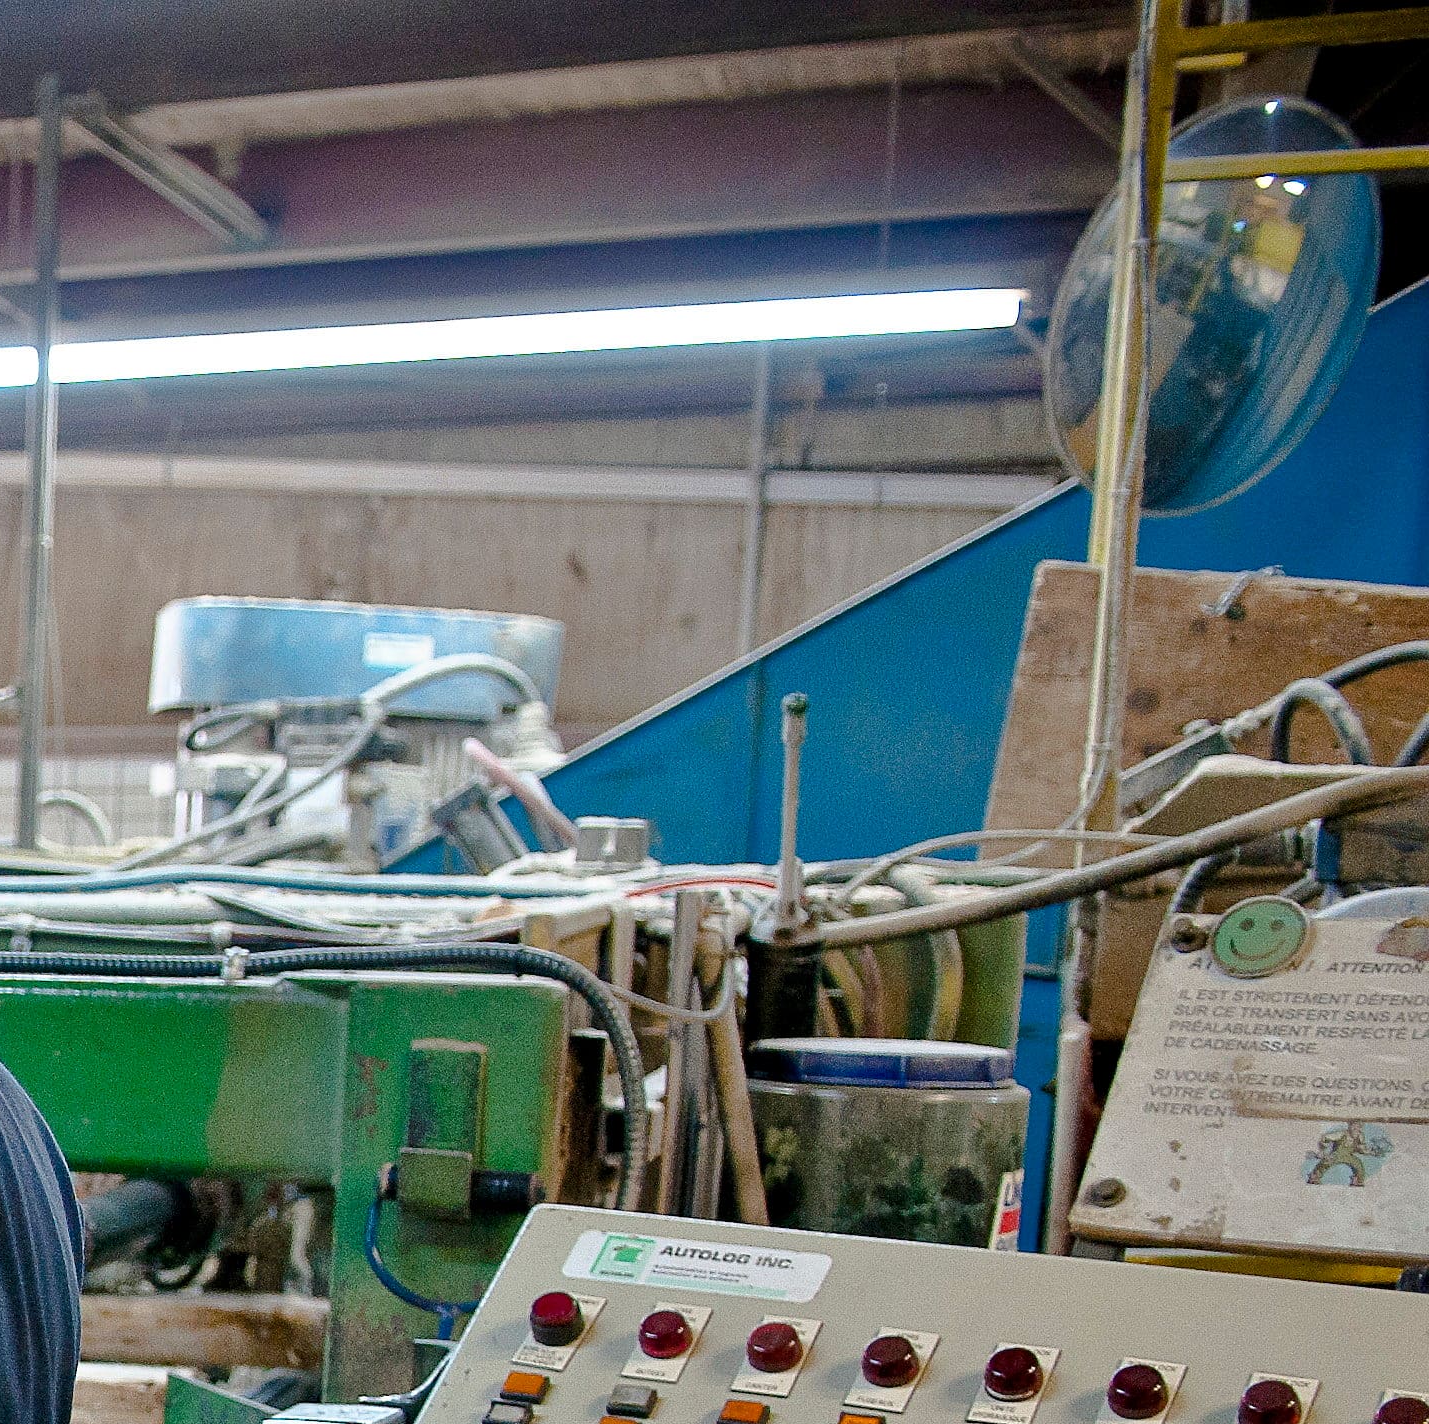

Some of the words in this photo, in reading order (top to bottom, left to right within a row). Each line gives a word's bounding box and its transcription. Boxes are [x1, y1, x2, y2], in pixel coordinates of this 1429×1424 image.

[1325, 961, 1425, 974] ATTENTION
[1177, 988, 1192, 1001] IL
[1196, 988, 1229, 1001] EST
[1232, 989, 1351, 1005] STRICTEMENT
[1173, 1004, 1208, 1017] SUR
[1212, 1006, 1236, 1018] CE
[1241, 1007, 1339, 1022] TRANSFERT
[1344, 1010, 1390, 1023] SANS
[1168, 1019, 1311, 1037] PRÉALABLEMENT
[1315, 1025, 1407, 1040] RESPECTÉ
[1163, 1036, 1188, 1048] DE
[1153, 1068, 1170, 1081] SI
[1174, 1070, 1220, 1083] VOUS
[1223, 1072, 1268, 1086] AVEZ
[1272, 1075, 1307, 1087] DES
[1148, 1084, 1206, 1099] VOTRE
[1347, 1095, 1406, 1108] AVANT
[659, 1244, 751, 1265] AUTOLOG
[755, 1254, 796, 1271] INC.
